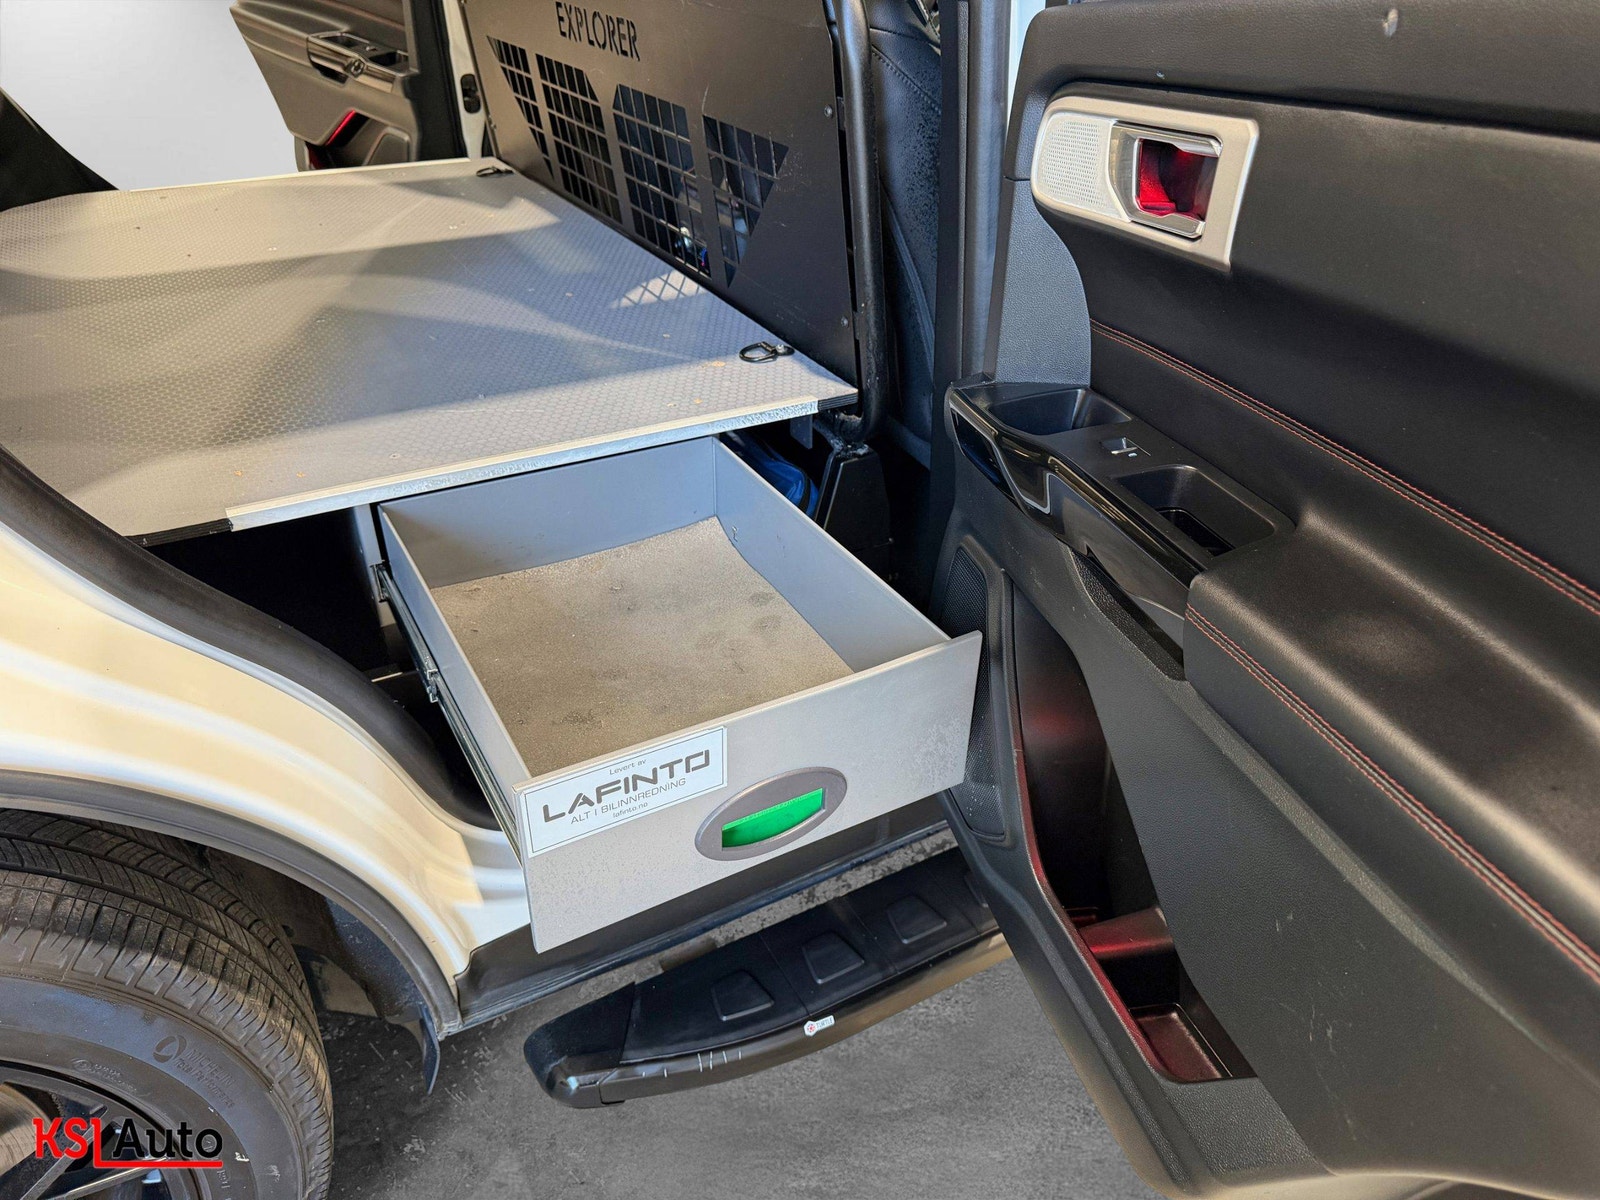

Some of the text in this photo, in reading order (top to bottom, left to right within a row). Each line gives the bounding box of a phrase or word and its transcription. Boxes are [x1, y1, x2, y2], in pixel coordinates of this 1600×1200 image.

[555, 1, 640, 61] EXPLORER
[542, 749, 710, 823] LAFINTO
[609, 759, 647, 775] Levert av
[570, 810, 591, 825] ALT
[601, 777, 687, 814] BILINNREDNING
[612, 802, 649, 818] lafinto.no
[185, 1049, 235, 1087] MICHELIN
